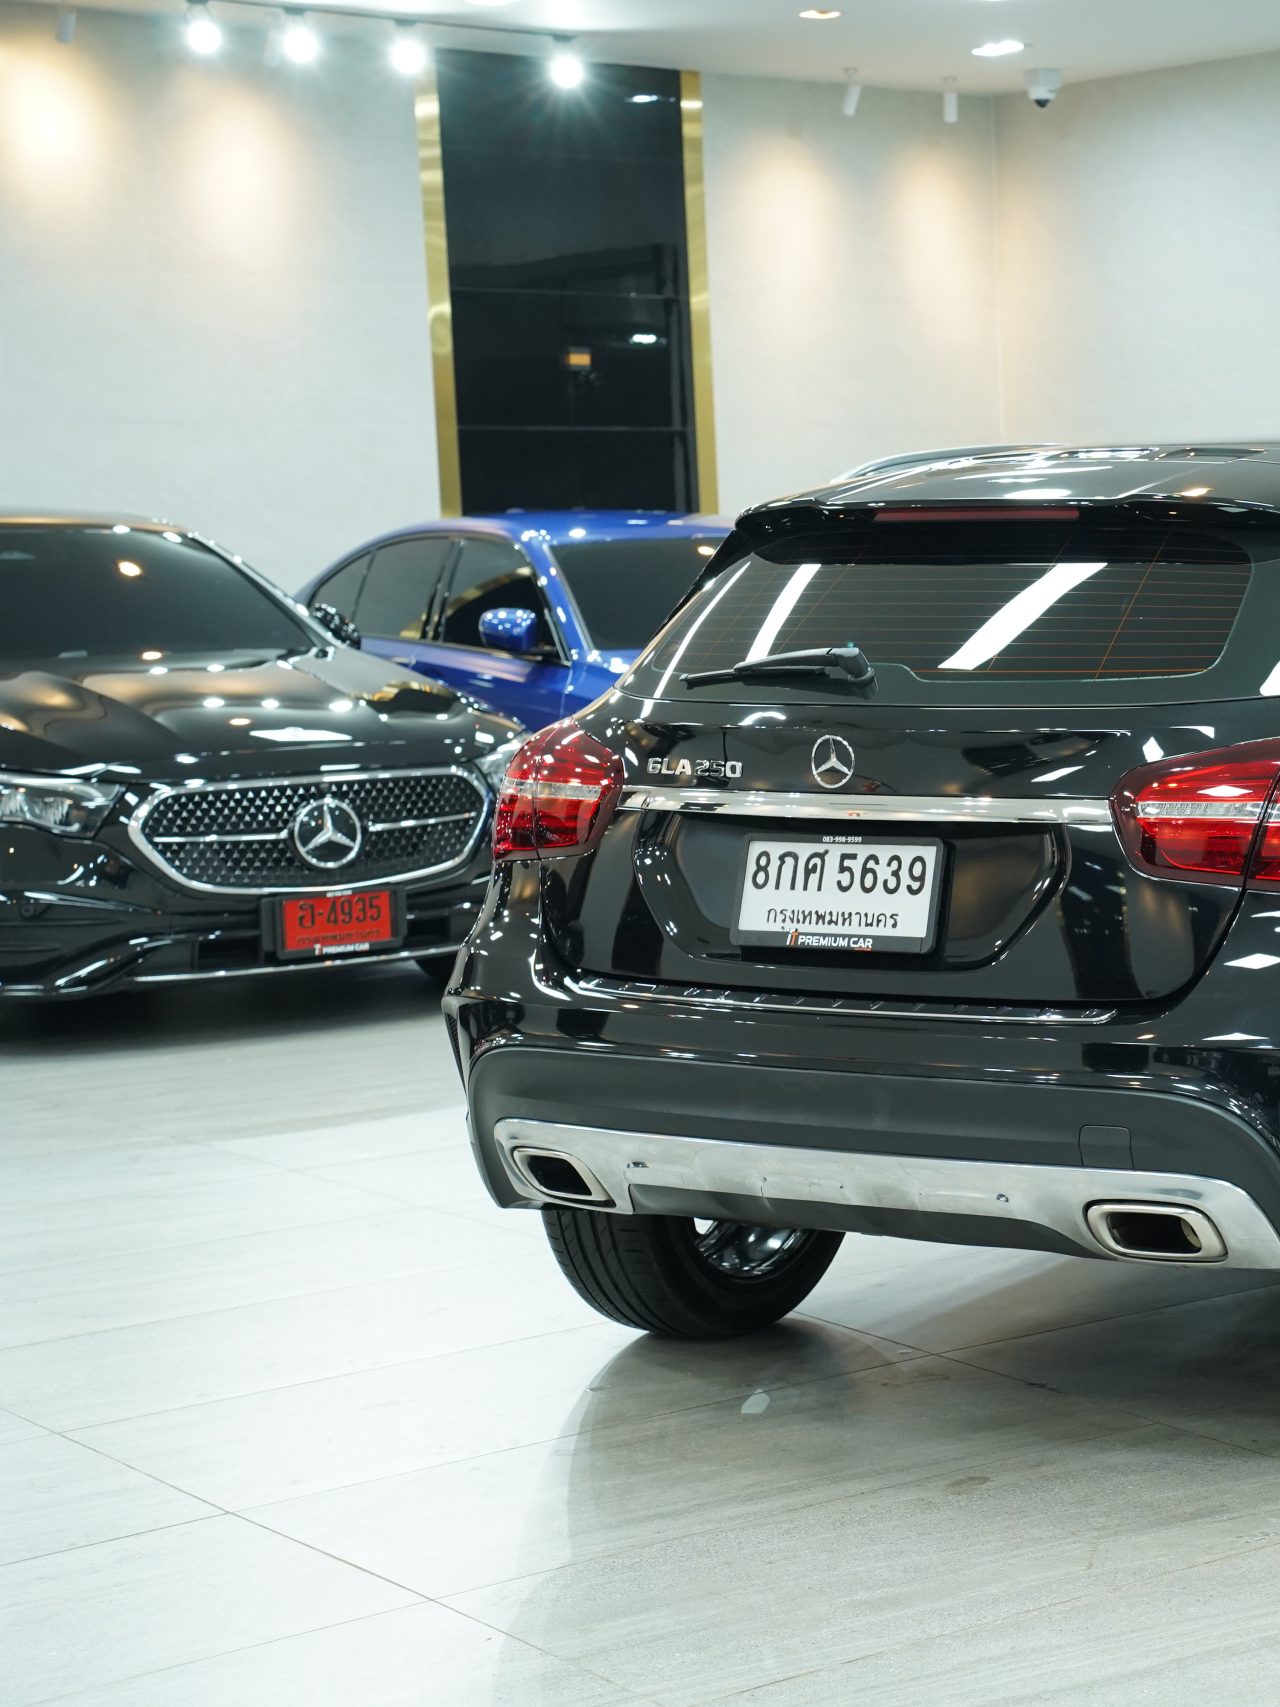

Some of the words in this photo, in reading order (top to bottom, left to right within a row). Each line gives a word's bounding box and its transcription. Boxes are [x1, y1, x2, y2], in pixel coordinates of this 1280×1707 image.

[647, 757, 692, 776] GLA
[694, 759, 744, 778] 250
[836, 852, 927, 896] 5639
[797, 935, 849, 947] PREMIUM
[849, 937, 873, 949] CAR
